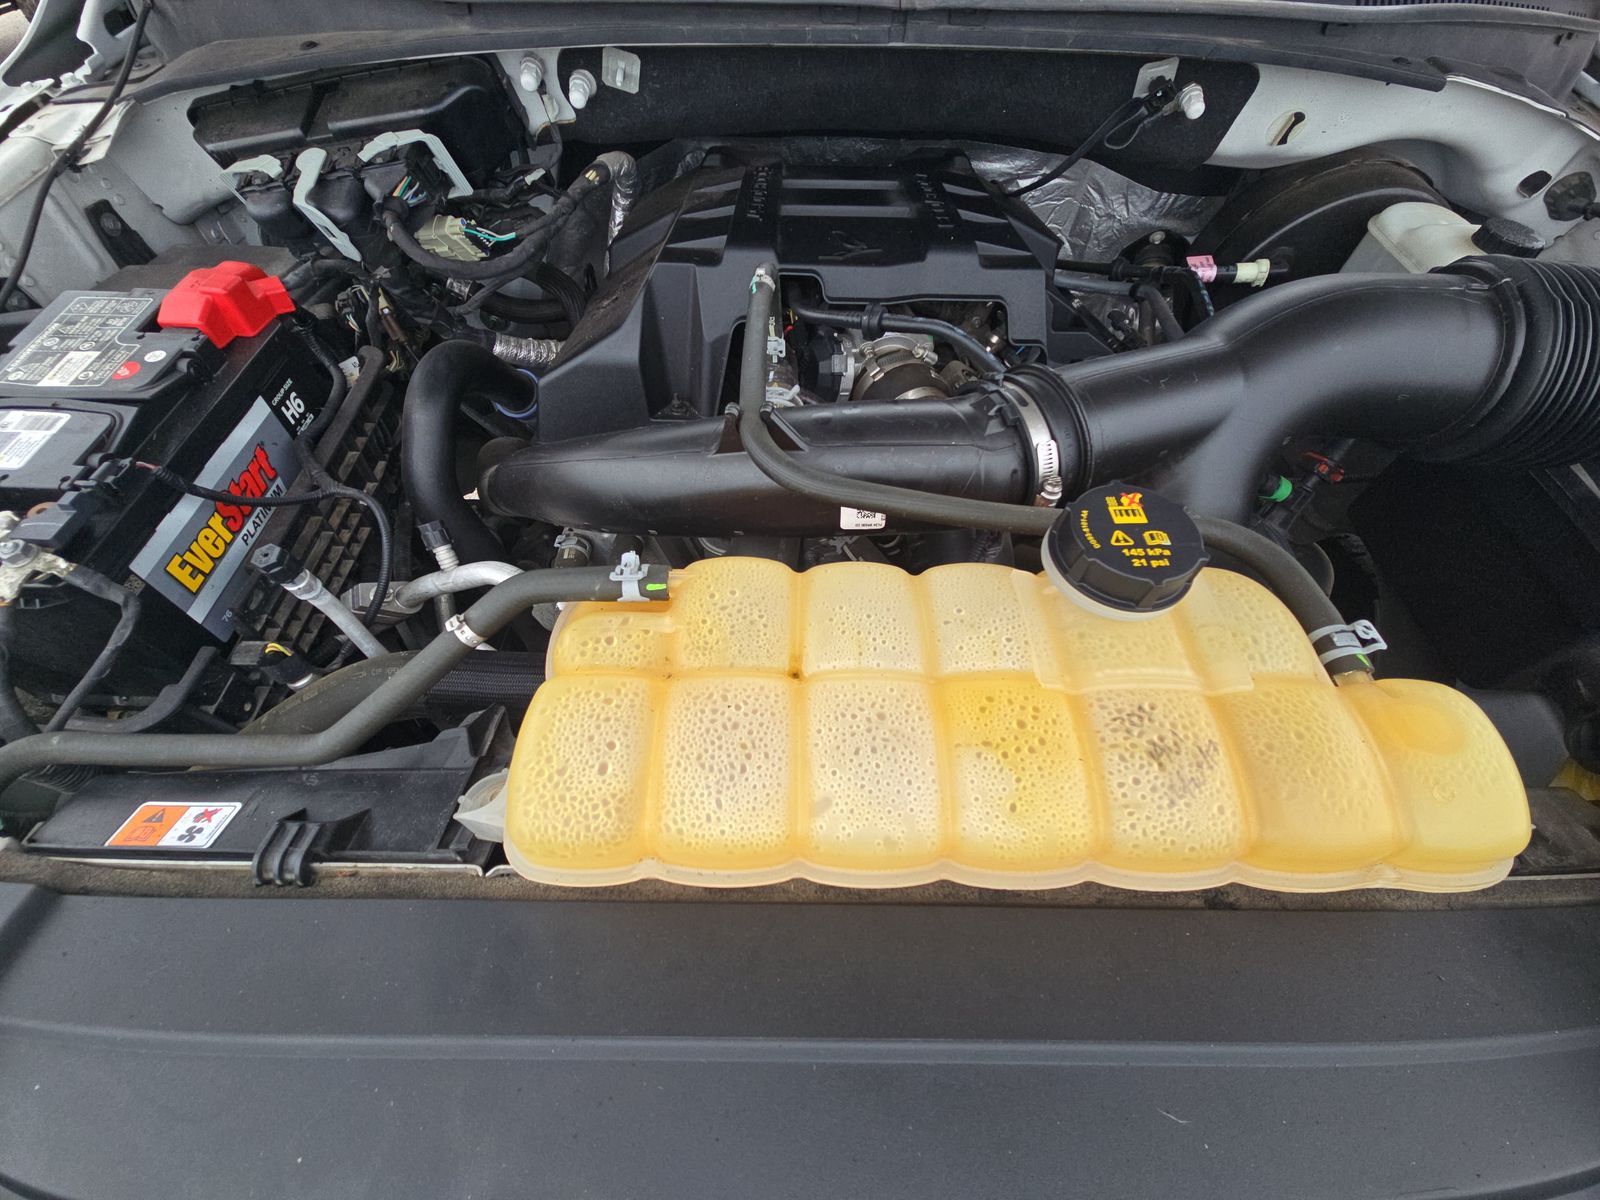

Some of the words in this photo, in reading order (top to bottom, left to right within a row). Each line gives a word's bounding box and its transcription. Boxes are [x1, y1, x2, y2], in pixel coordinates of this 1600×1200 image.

[272, 387, 285, 406] GROUP
[281, 391, 305, 425] H6
[164, 443, 278, 594] EverStart
[1122, 548, 1146, 556] 145
[1147, 548, 1172, 556] kPa
[1131, 558, 1148, 567] 21
[1150, 558, 1170, 568] psi
